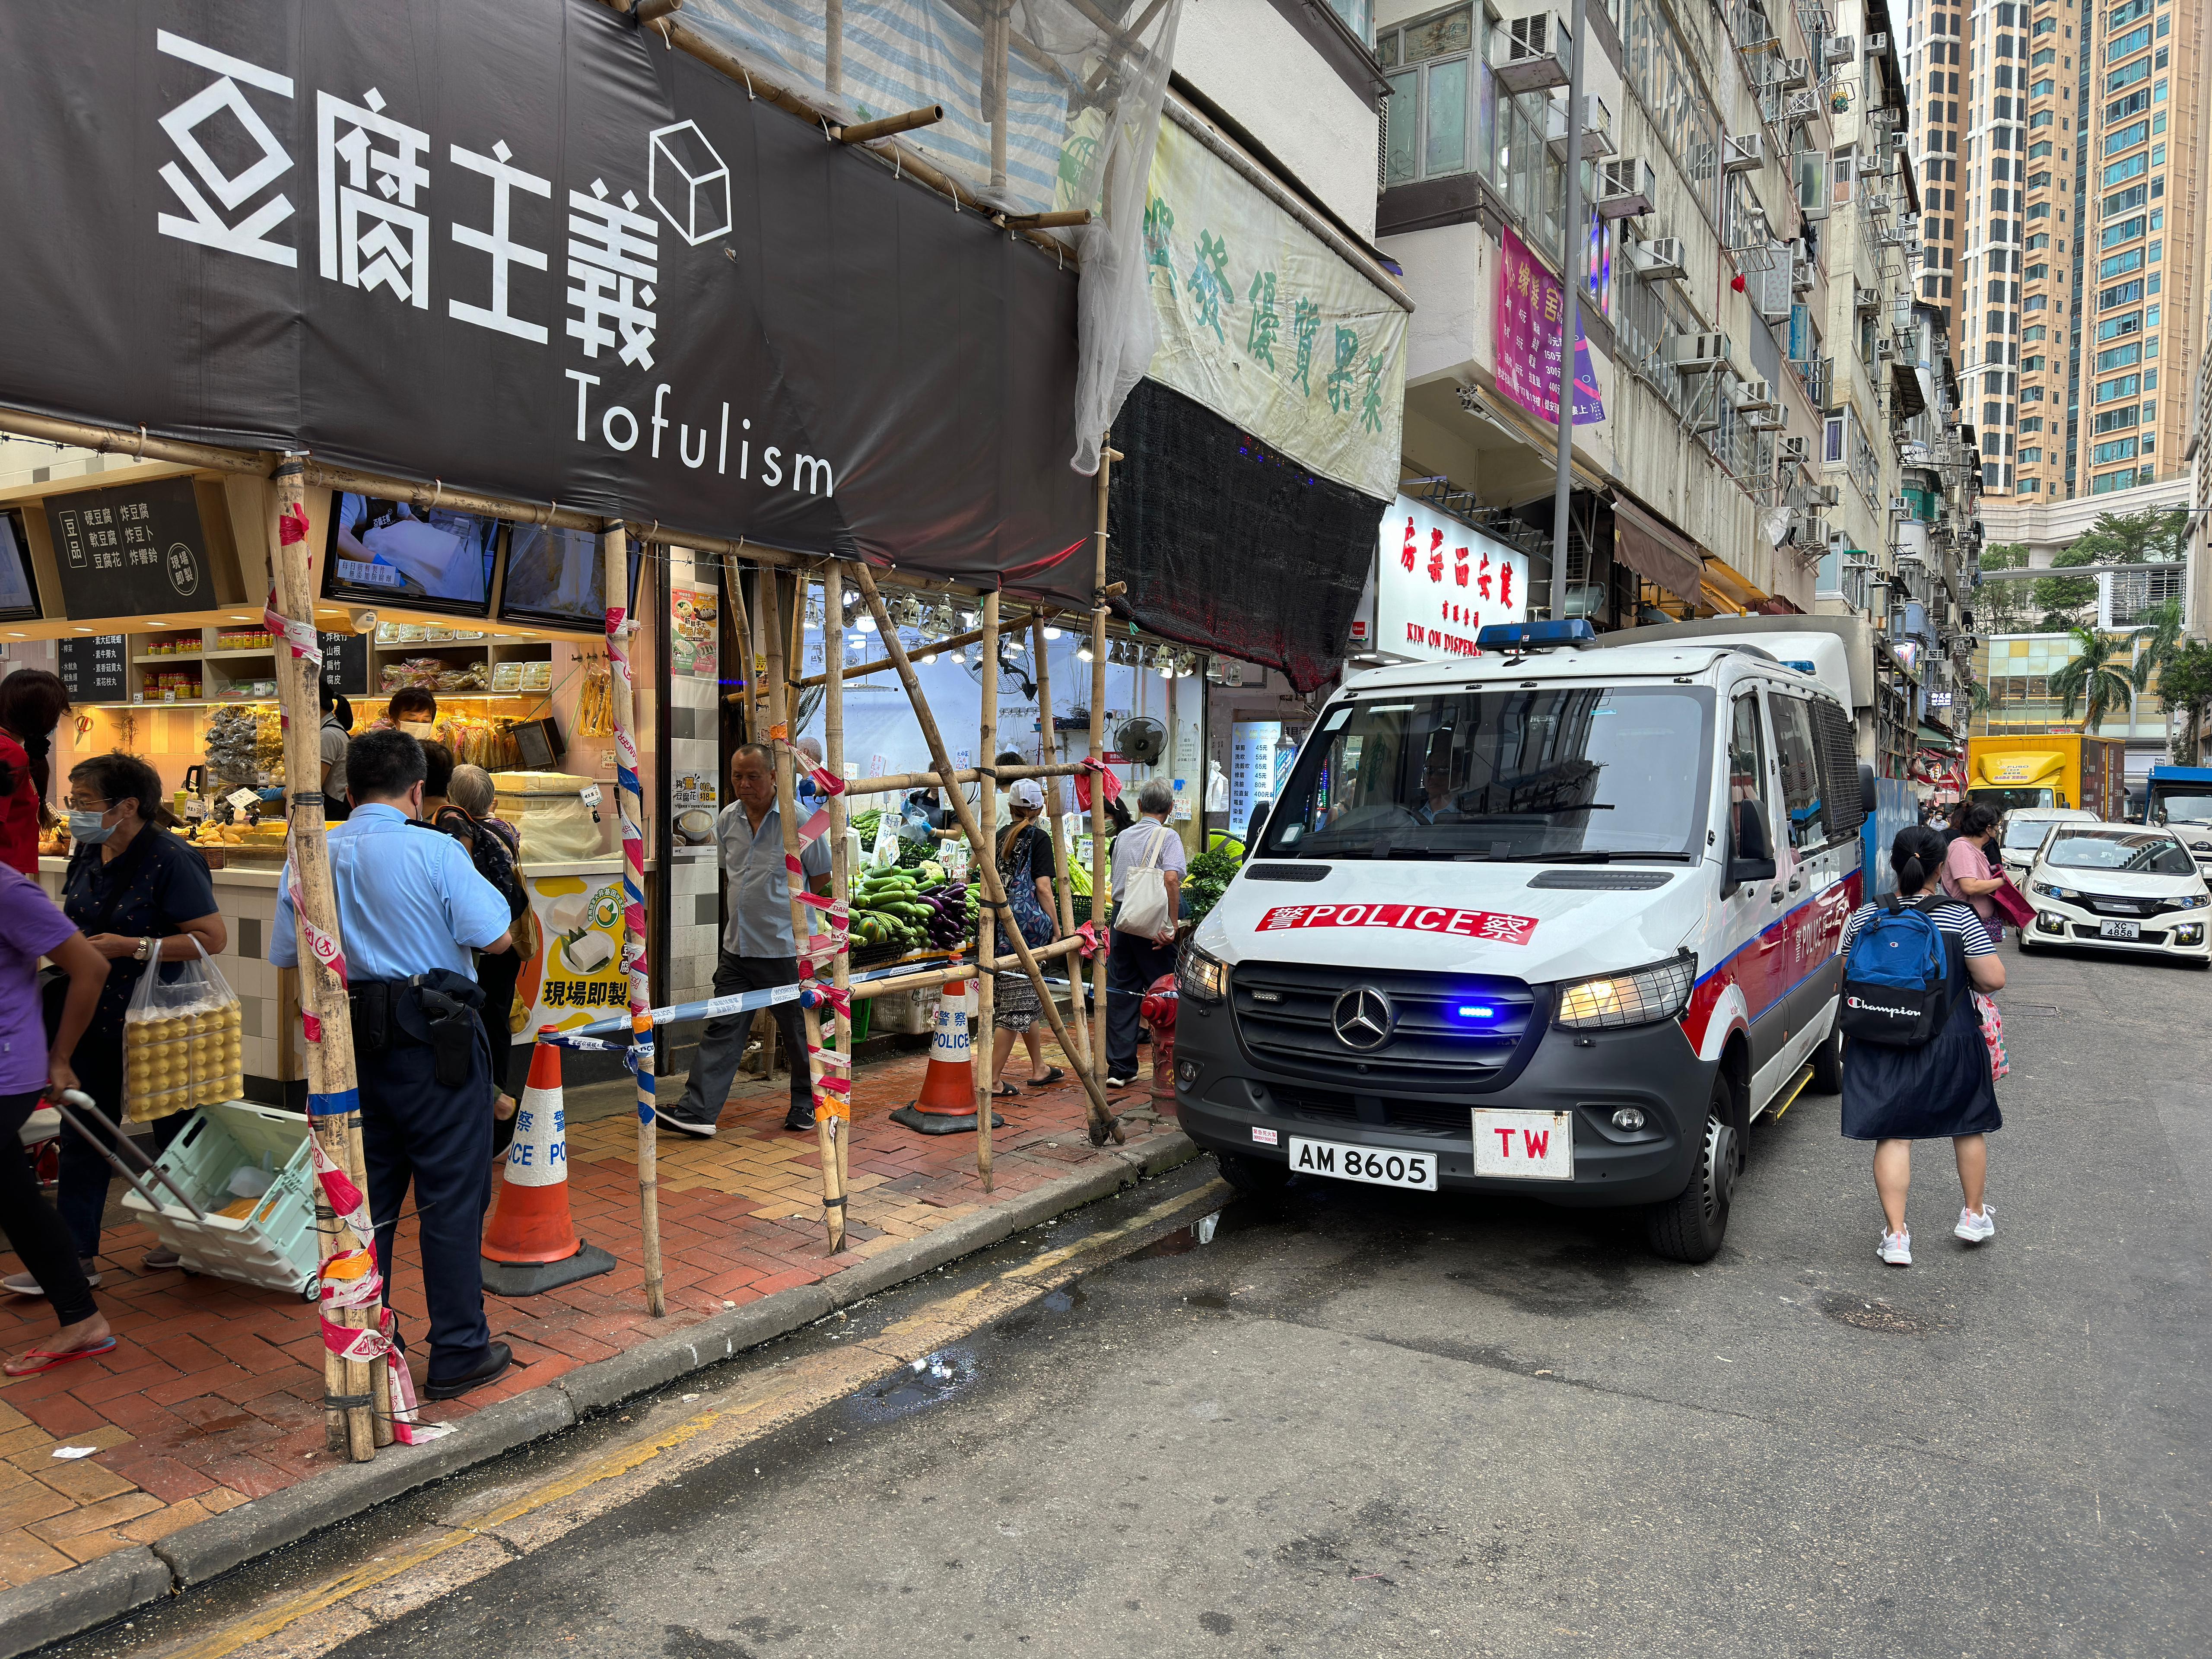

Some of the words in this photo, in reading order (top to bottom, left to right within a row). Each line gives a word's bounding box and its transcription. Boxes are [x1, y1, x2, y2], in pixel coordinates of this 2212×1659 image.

[157, 28, 658, 372] 豆腐主義
[564, 369, 834, 498] Tofulism
[83, 508, 112, 526] 硬豆腐
[120, 502, 149, 522] 炸豆腐
[64, 518, 82, 559] 豆品
[88, 529, 117, 548] 軟豆腐
[124, 524, 153, 544] 炸豆卜
[93, 551, 122, 569] 豆腐花
[129, 547, 158, 566] 炸響鈴
[342, 561, 385, 575] 每日新鮮製作
[349, 570, 392, 583] 無添加防腐劑
[684, 617, 706, 628] 新鮮手工
[1407, 622, 1425, 643] KIN
[1428, 629, 1442, 648] ON
[327, 645, 341, 656] 山根
[95, 662, 122, 672] 素香菇貢丸
[96, 677, 117, 686] 素花枝丸
[327, 674, 341, 685] 腐皮
[676, 791, 696, 802] 豆腐花
[1266, 906, 1303, 929] 警
[1302, 904, 1474, 935] POLICE
[1479, 914, 1529, 946] 察
[2107, 929, 2133, 937] 4858
[1802, 916, 1822, 958] POLICE
[543, 981, 627, 1007] 現場即製
[1847, 996, 1921, 1018] Champion
[939, 1010, 966, 1027] 警察
[932, 1032, 970, 1050] POLICE
[1253, 1128, 1277, 1138] 緊急死火掣
[1493, 1128, 1549, 1160] TW
[1298, 1144, 1335, 1173] AM
[1344, 1150, 1427, 1184] 8605
